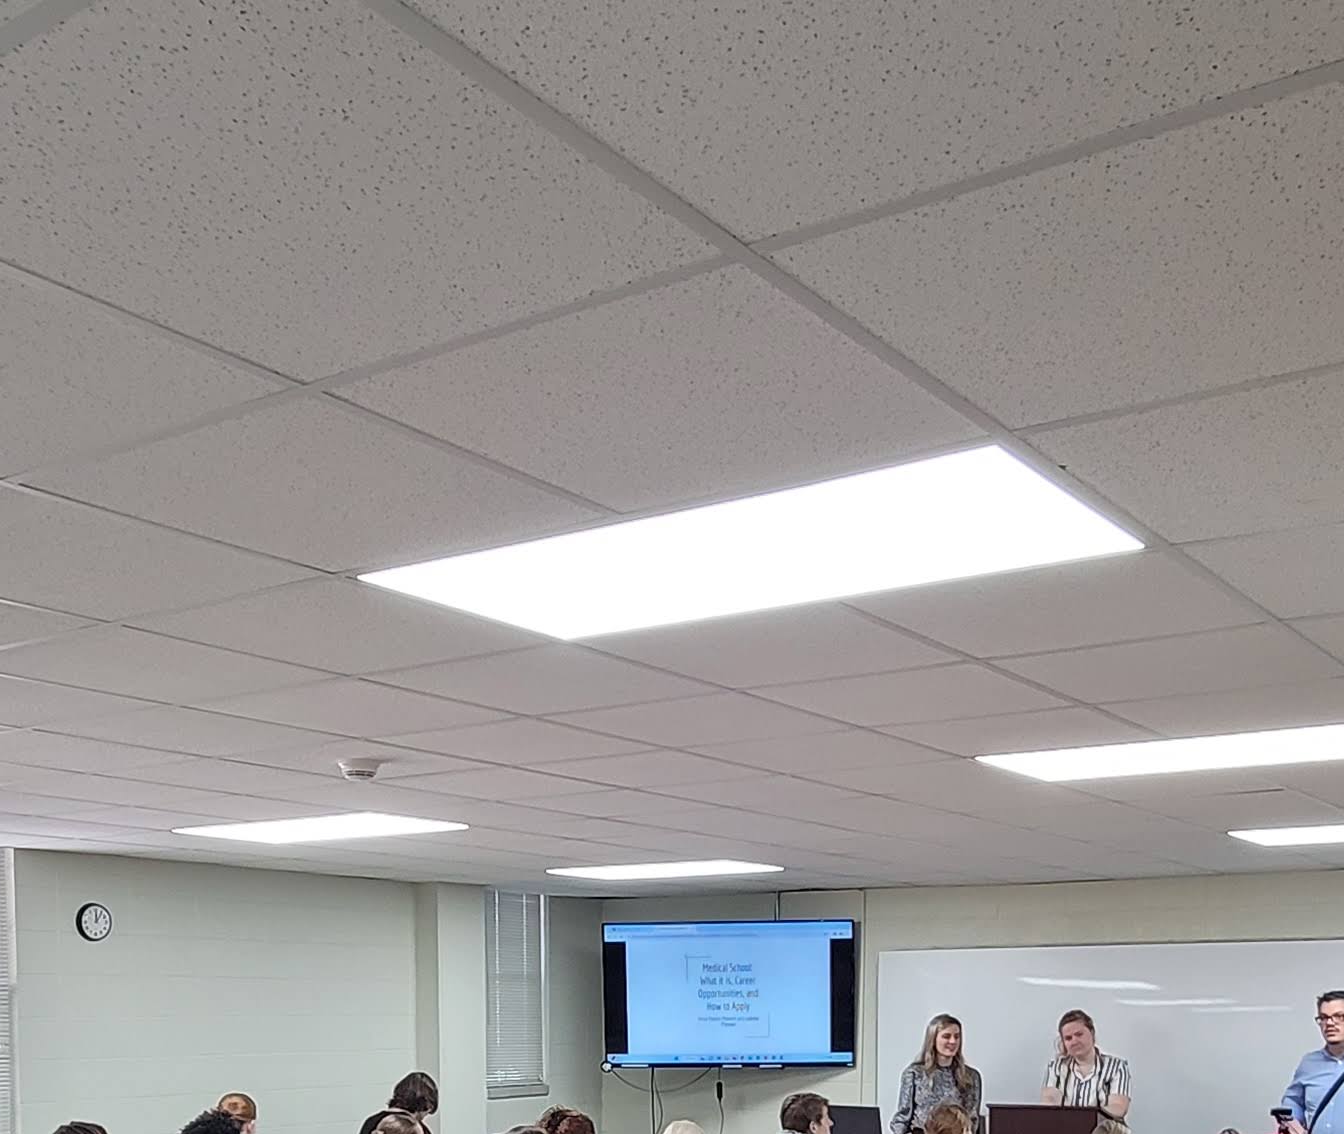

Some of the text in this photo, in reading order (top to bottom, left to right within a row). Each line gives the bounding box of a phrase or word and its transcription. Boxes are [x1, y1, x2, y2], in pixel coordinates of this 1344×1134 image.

[702, 963, 728, 973] Medical
[700, 976, 716, 985] What
[734, 976, 756, 985] Career
[746, 989, 759, 997] and
[706, 1001, 750, 1012] How to Apply
